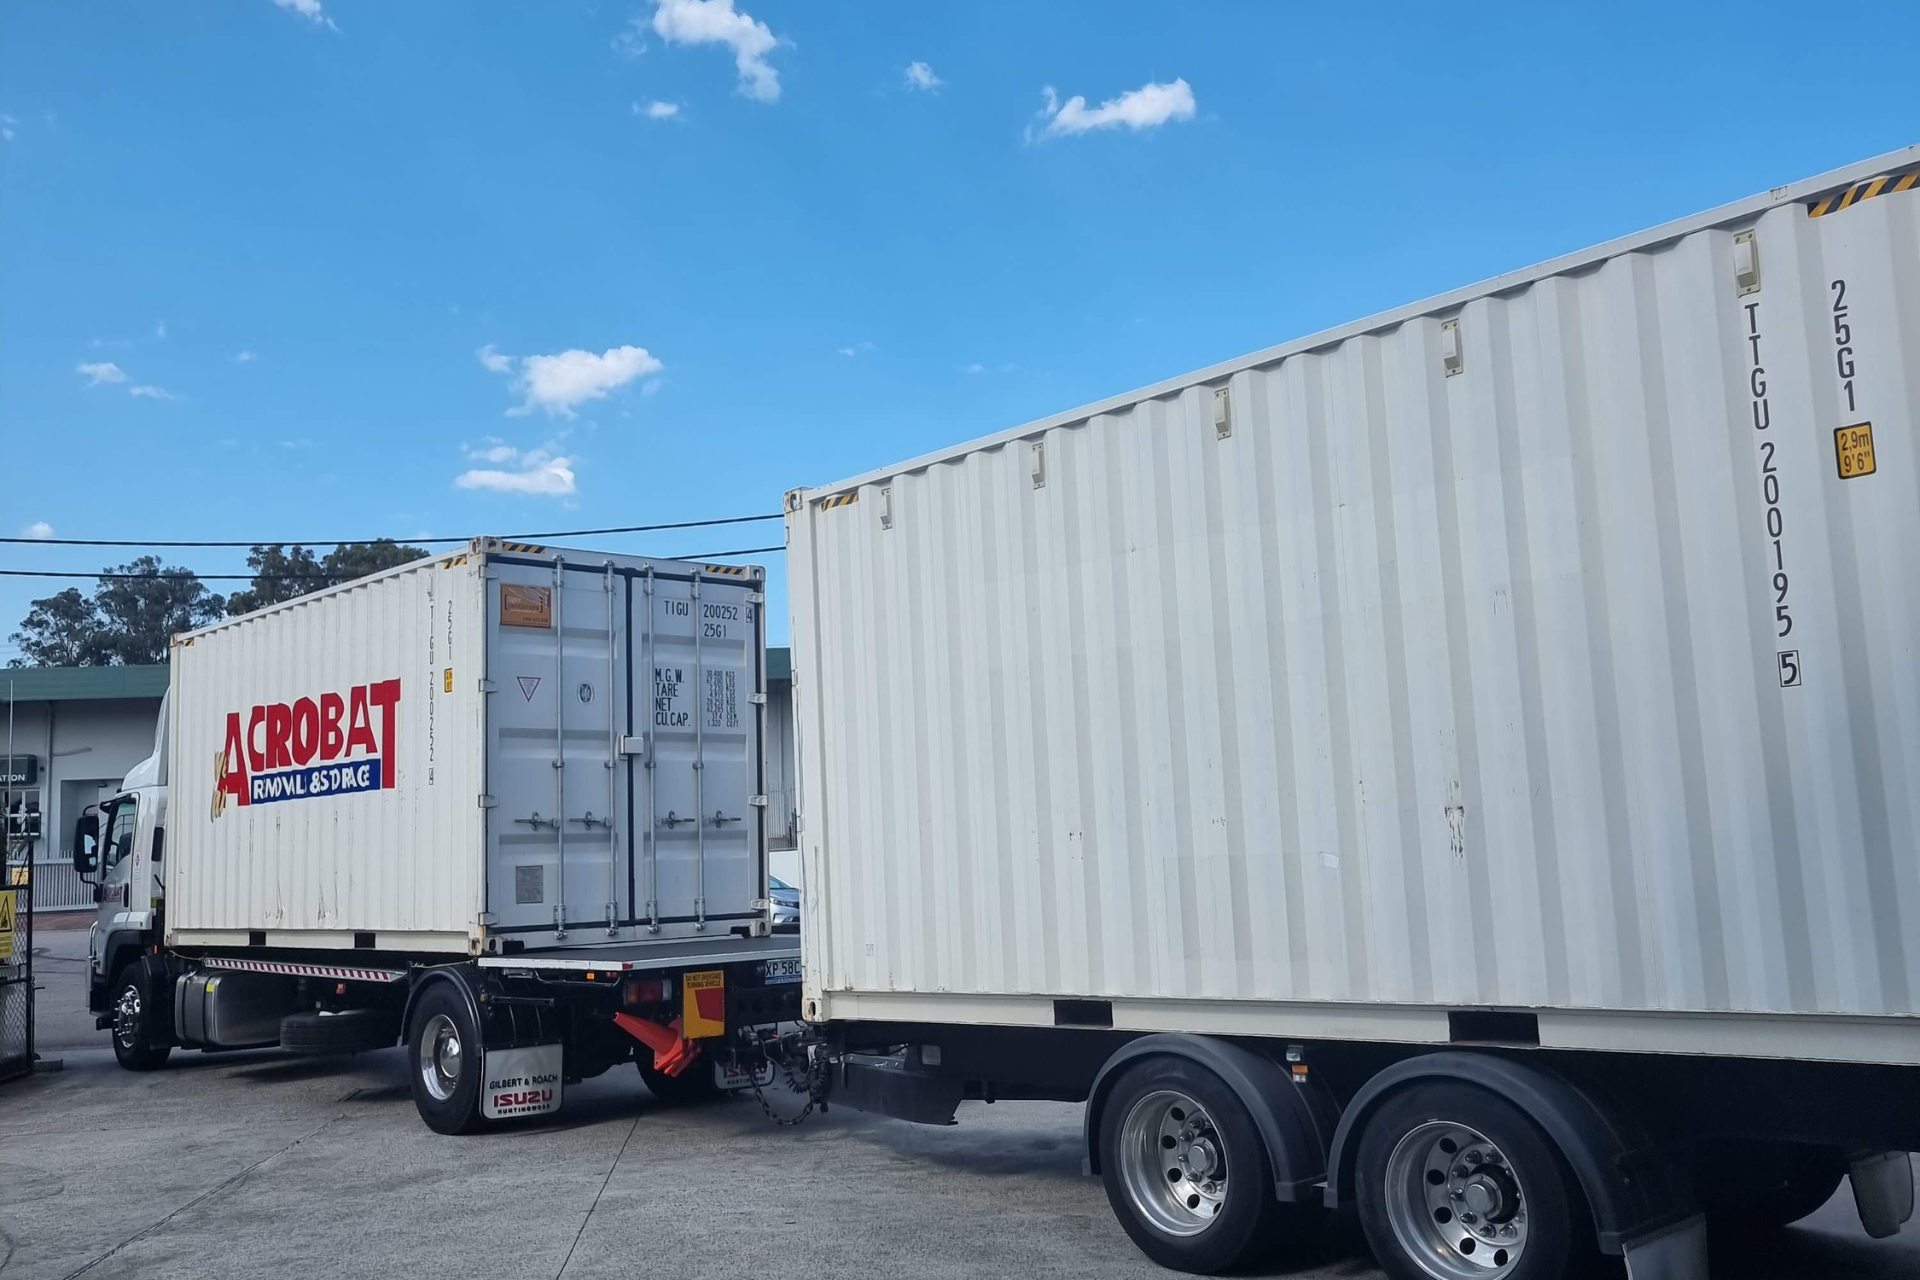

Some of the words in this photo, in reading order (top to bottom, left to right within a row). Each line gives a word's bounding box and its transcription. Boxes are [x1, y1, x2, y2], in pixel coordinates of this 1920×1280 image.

[1831, 279, 1856, 412] 25G1
[1759, 441, 1793, 638] 200195
[664, 600, 689, 616] TIGU
[703, 603, 739, 620] 200252
[703, 623, 727, 638] 25G1
[655, 668, 685, 683] M.G.W.
[655, 682, 679, 697] TARE
[655, 697, 672, 712] NET
[655, 711, 691, 727] CU.CAP.
[217, 677, 401, 806] ACROBAT
[765, 961, 779, 976] XP
[489, 1078, 523, 1090] GILBERT
[524, 1078, 530, 1086] &
[532, 1074, 558, 1086] ROACH
[494, 1089, 553, 1108] ISUZU
